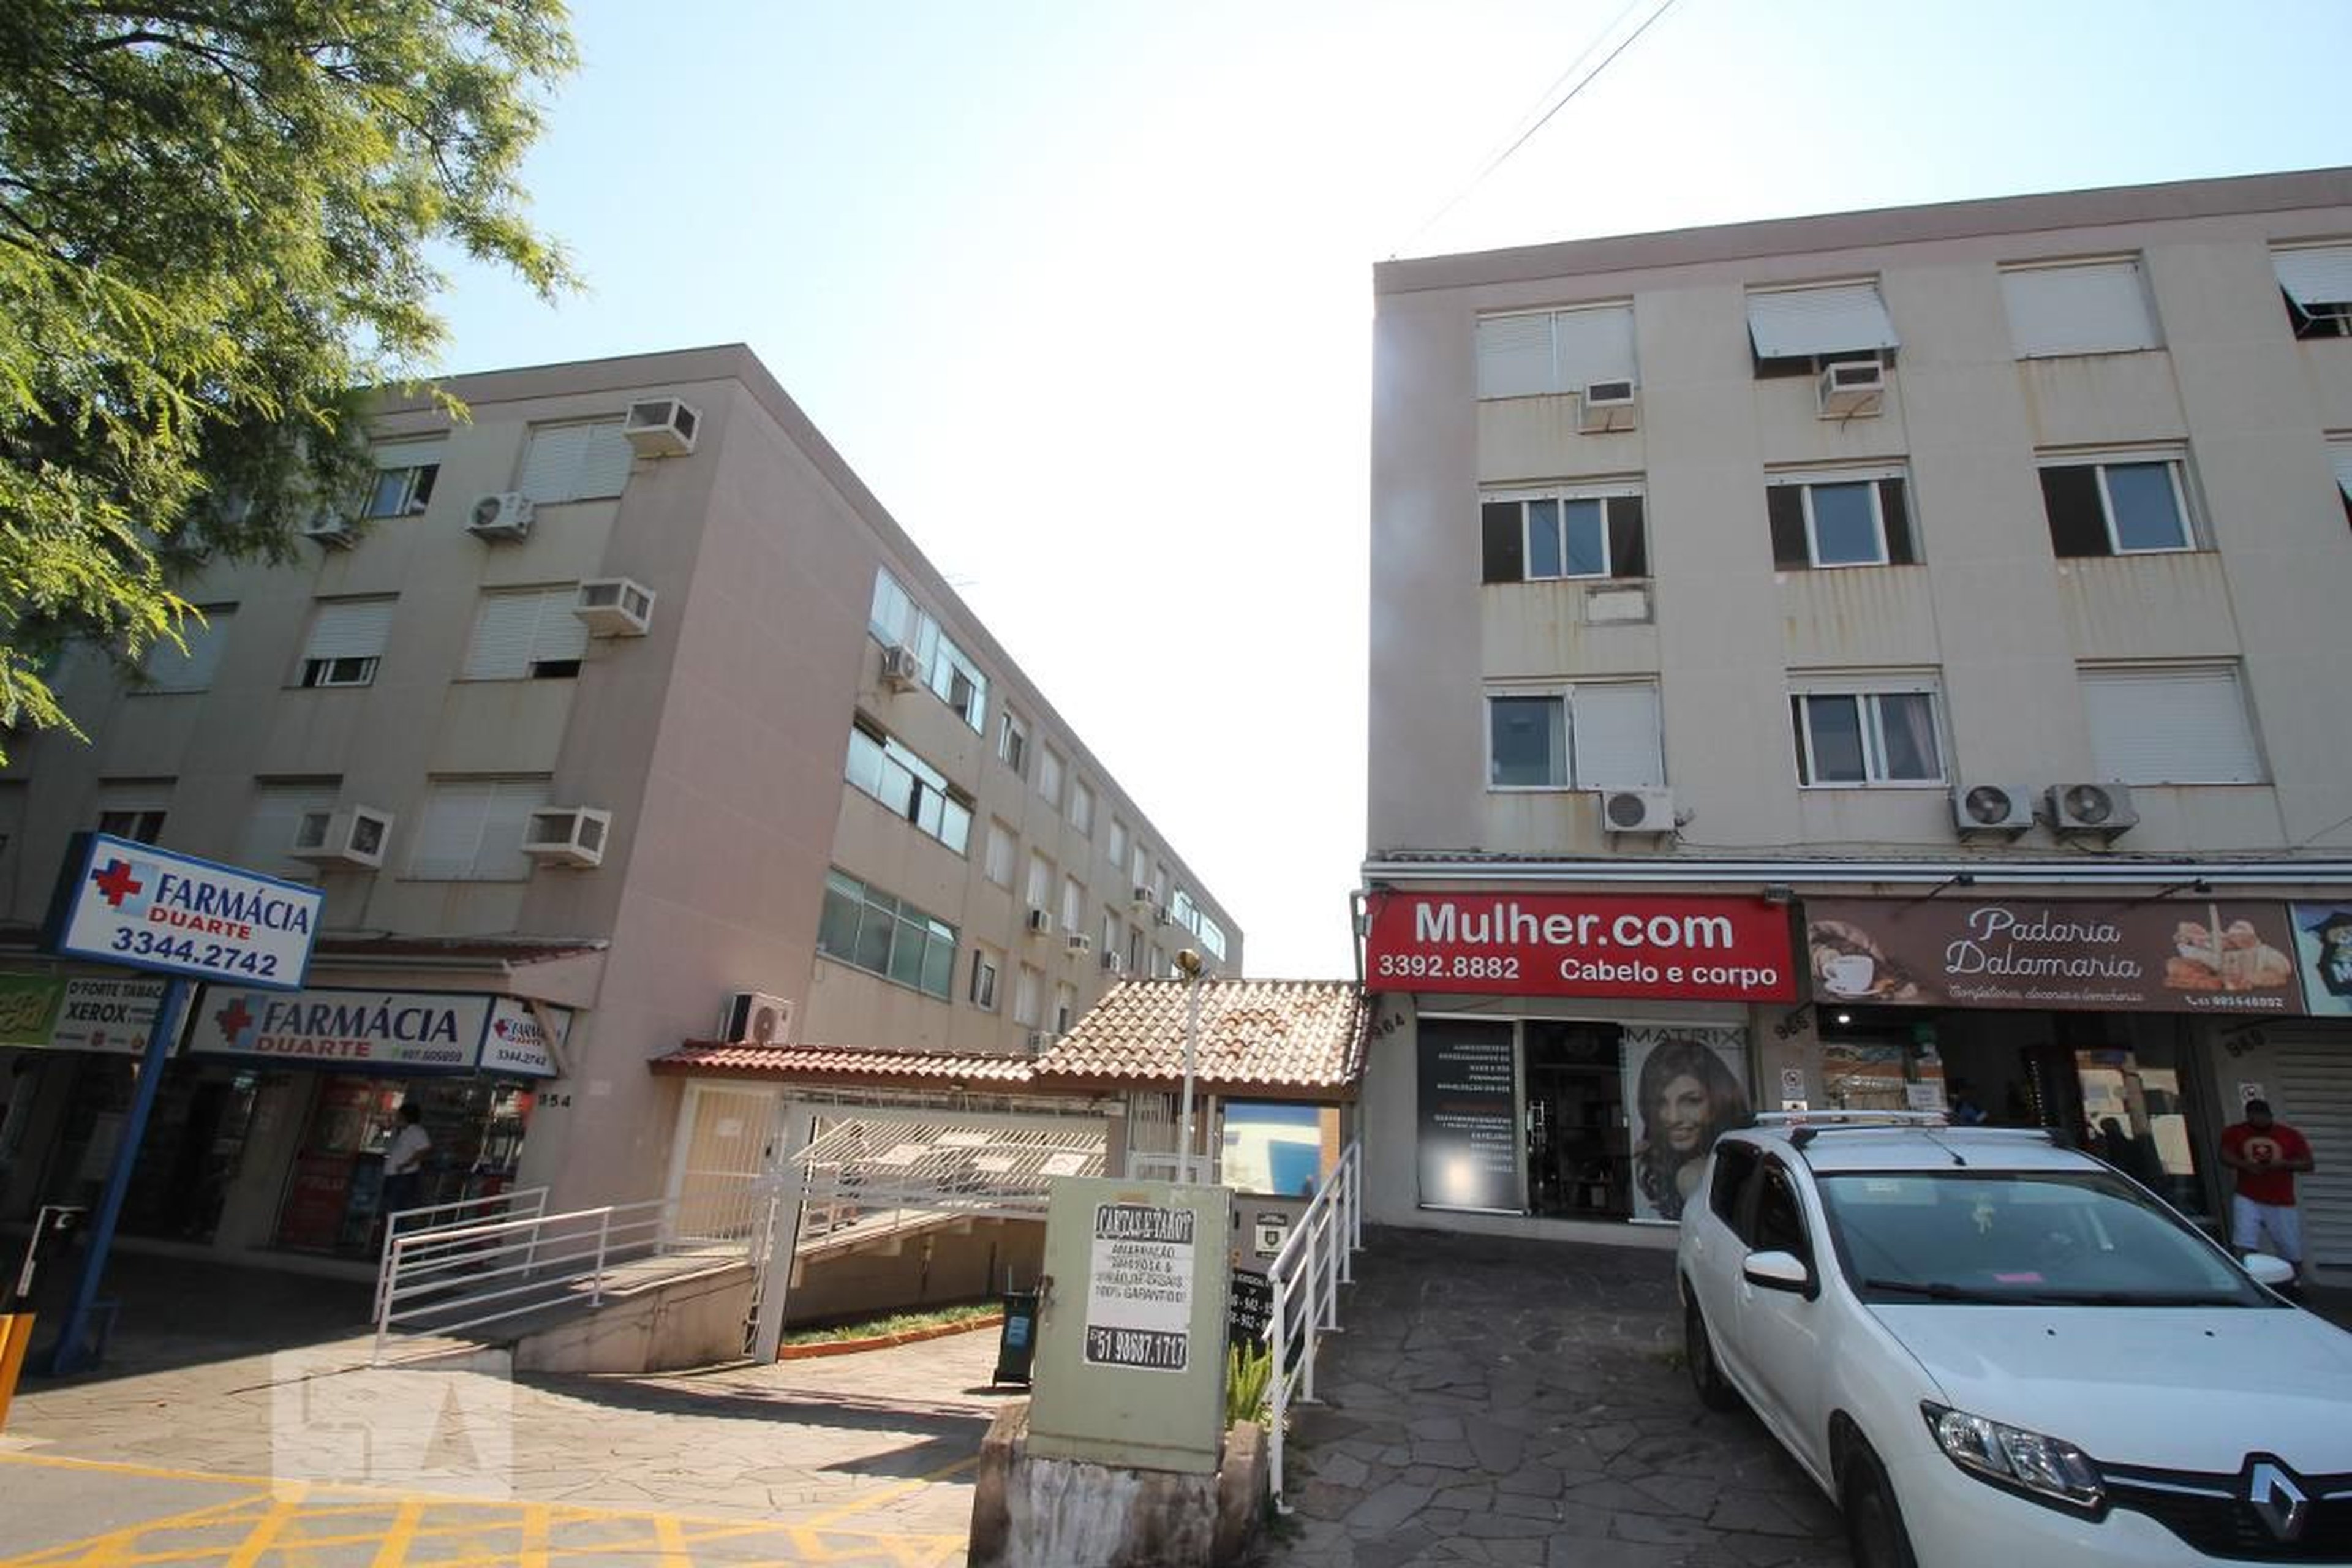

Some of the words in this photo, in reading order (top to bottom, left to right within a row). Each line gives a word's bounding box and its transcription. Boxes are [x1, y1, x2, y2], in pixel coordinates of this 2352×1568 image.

[155, 873, 309, 935] FARMÁCIA
[148, 907, 252, 940] DUARTE
[1415, 902, 1733, 948] Mulher.com
[1969, 907, 2120, 943] Padaria
[111, 927, 279, 976] 3344.2742
[1945, 940, 2142, 978] Dalamaria
[1379, 955, 1519, 979] 3392.8882
[1560, 958, 1658, 982] Cabelo
[1666, 964, 1683, 982] e
[1692, 964, 1777, 989] corpo
[261, 997, 458, 1042] FARMÁCIA
[1626, 1028, 1743, 1046] MATRIX
[255, 1036, 372, 1058] DUARTE
